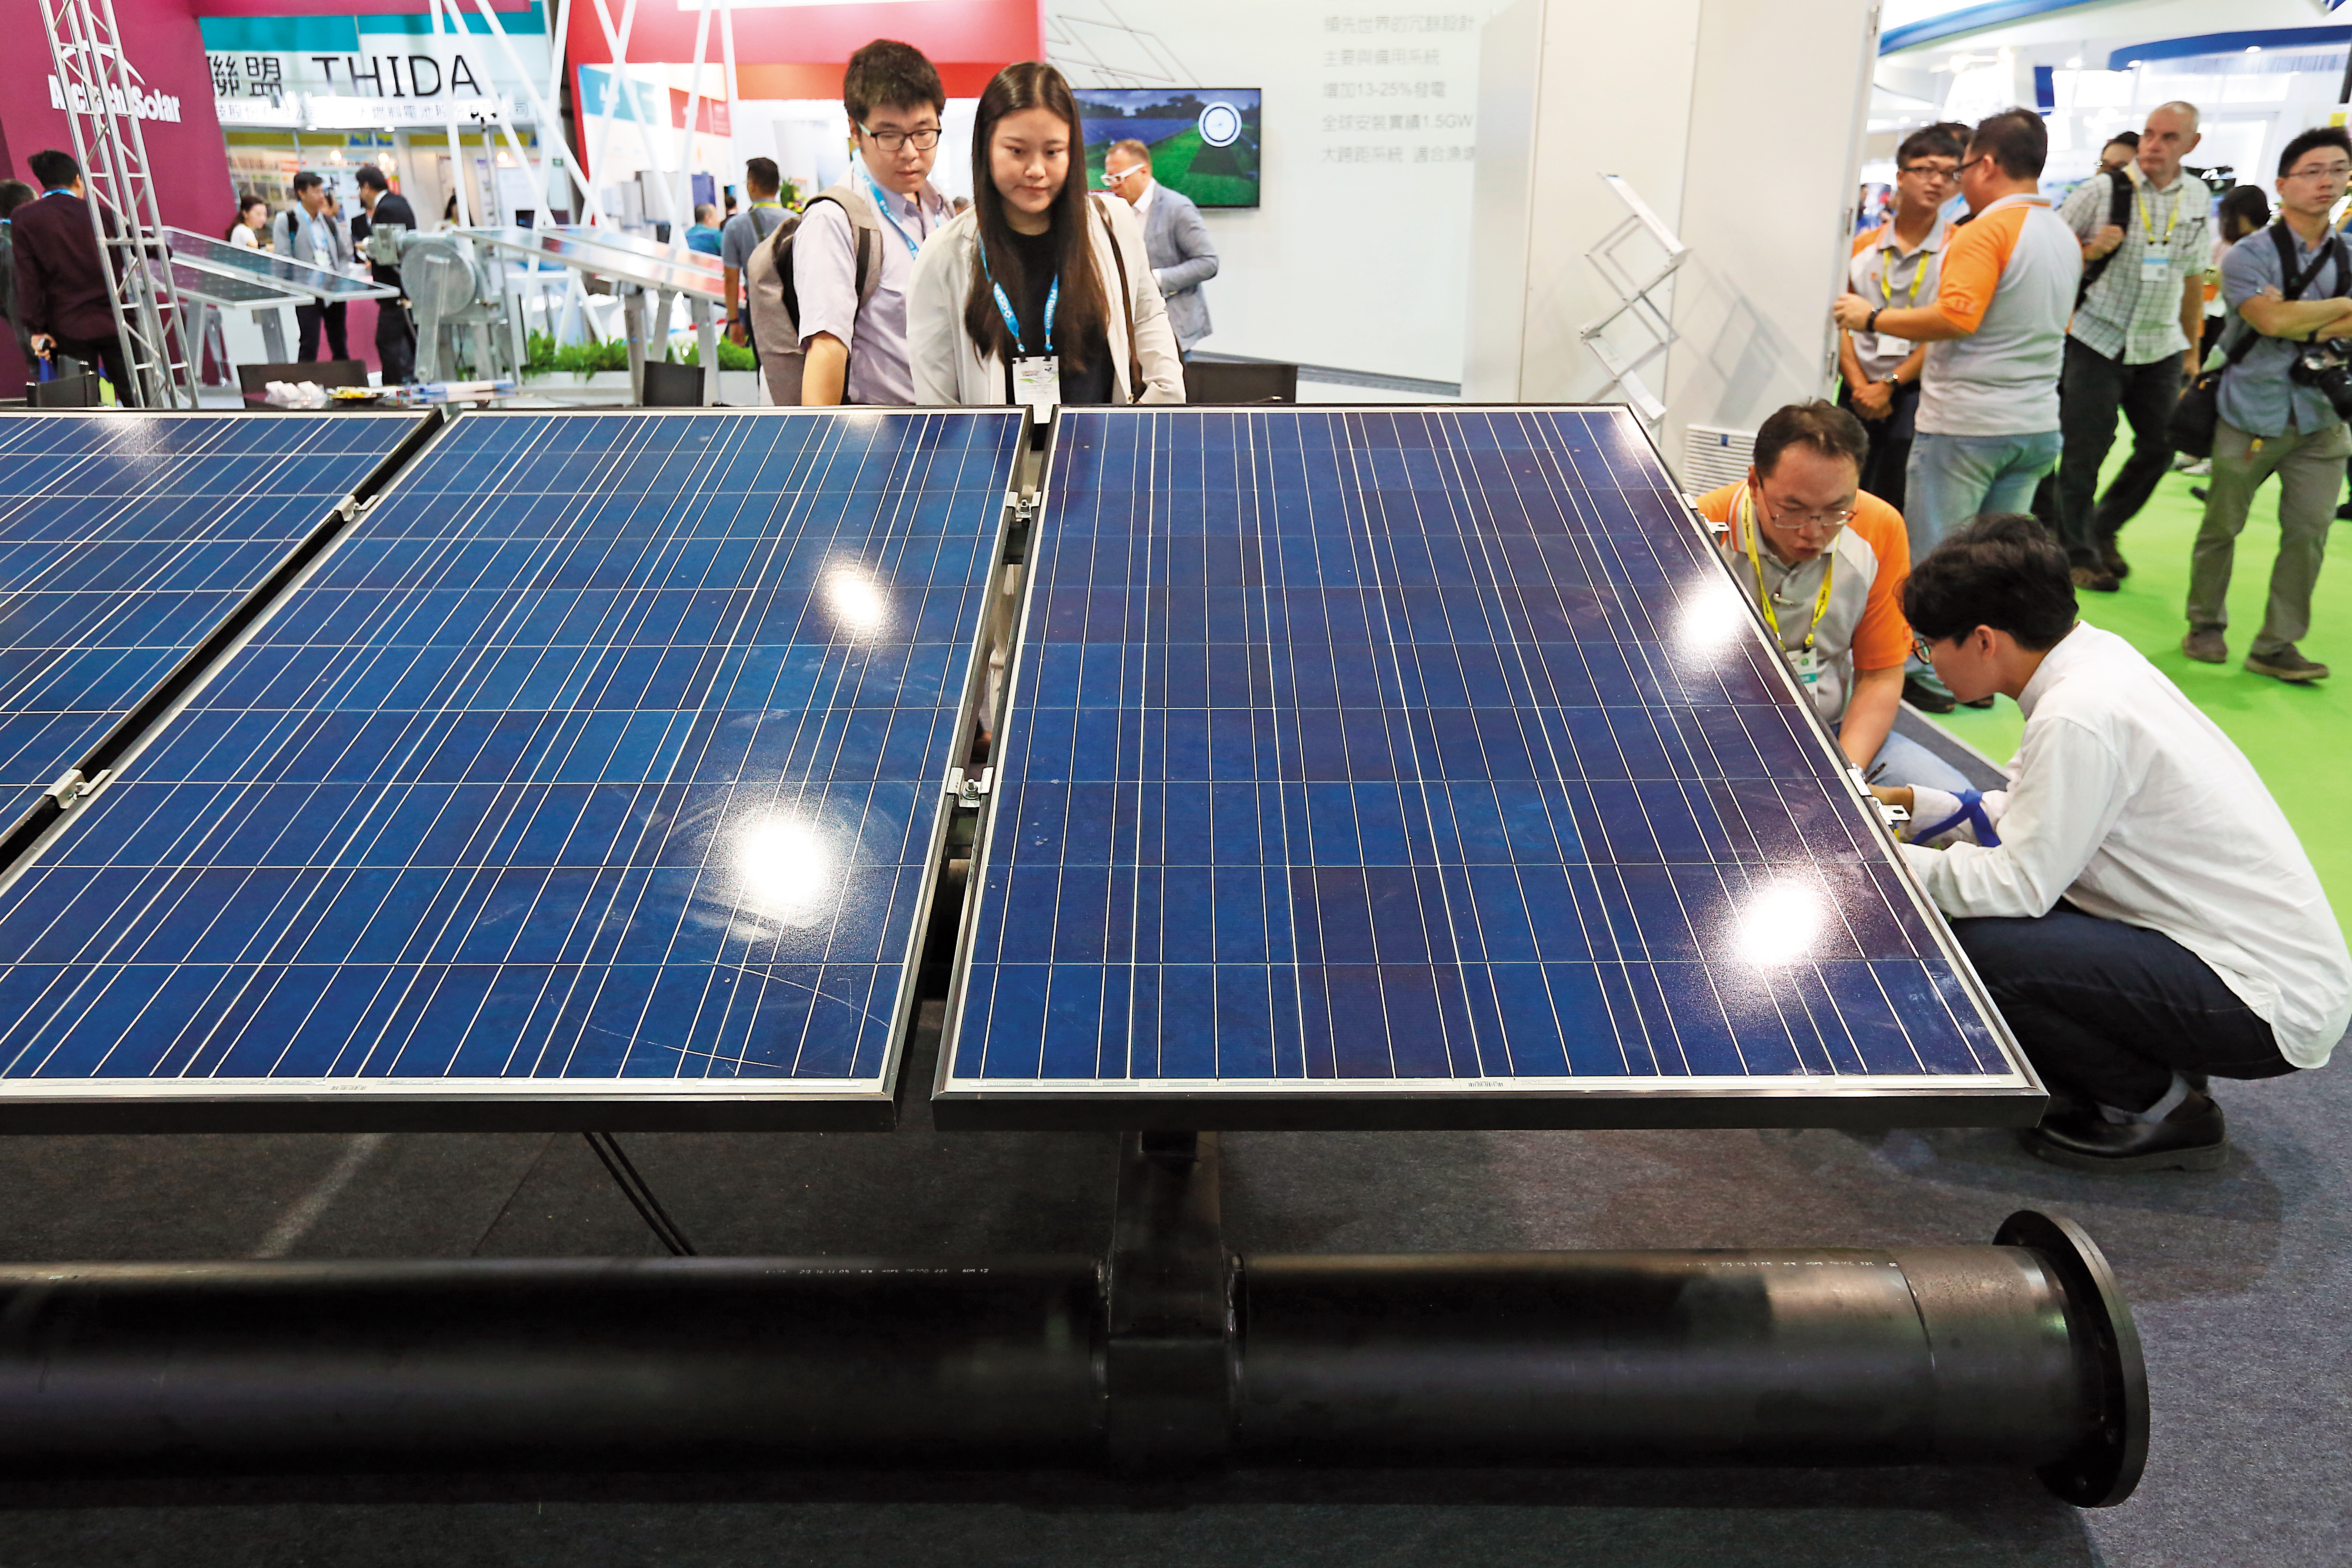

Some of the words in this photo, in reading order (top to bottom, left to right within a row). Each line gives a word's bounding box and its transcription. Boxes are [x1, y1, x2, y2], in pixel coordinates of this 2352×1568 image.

[208, 56, 283, 97] 聯盟
[312, 55, 483, 98] THIDA
[131, 85, 181, 123] Solar
[1050, 289, 1057, 299] PV
[1046, 300, 1056, 328] Taiwan
